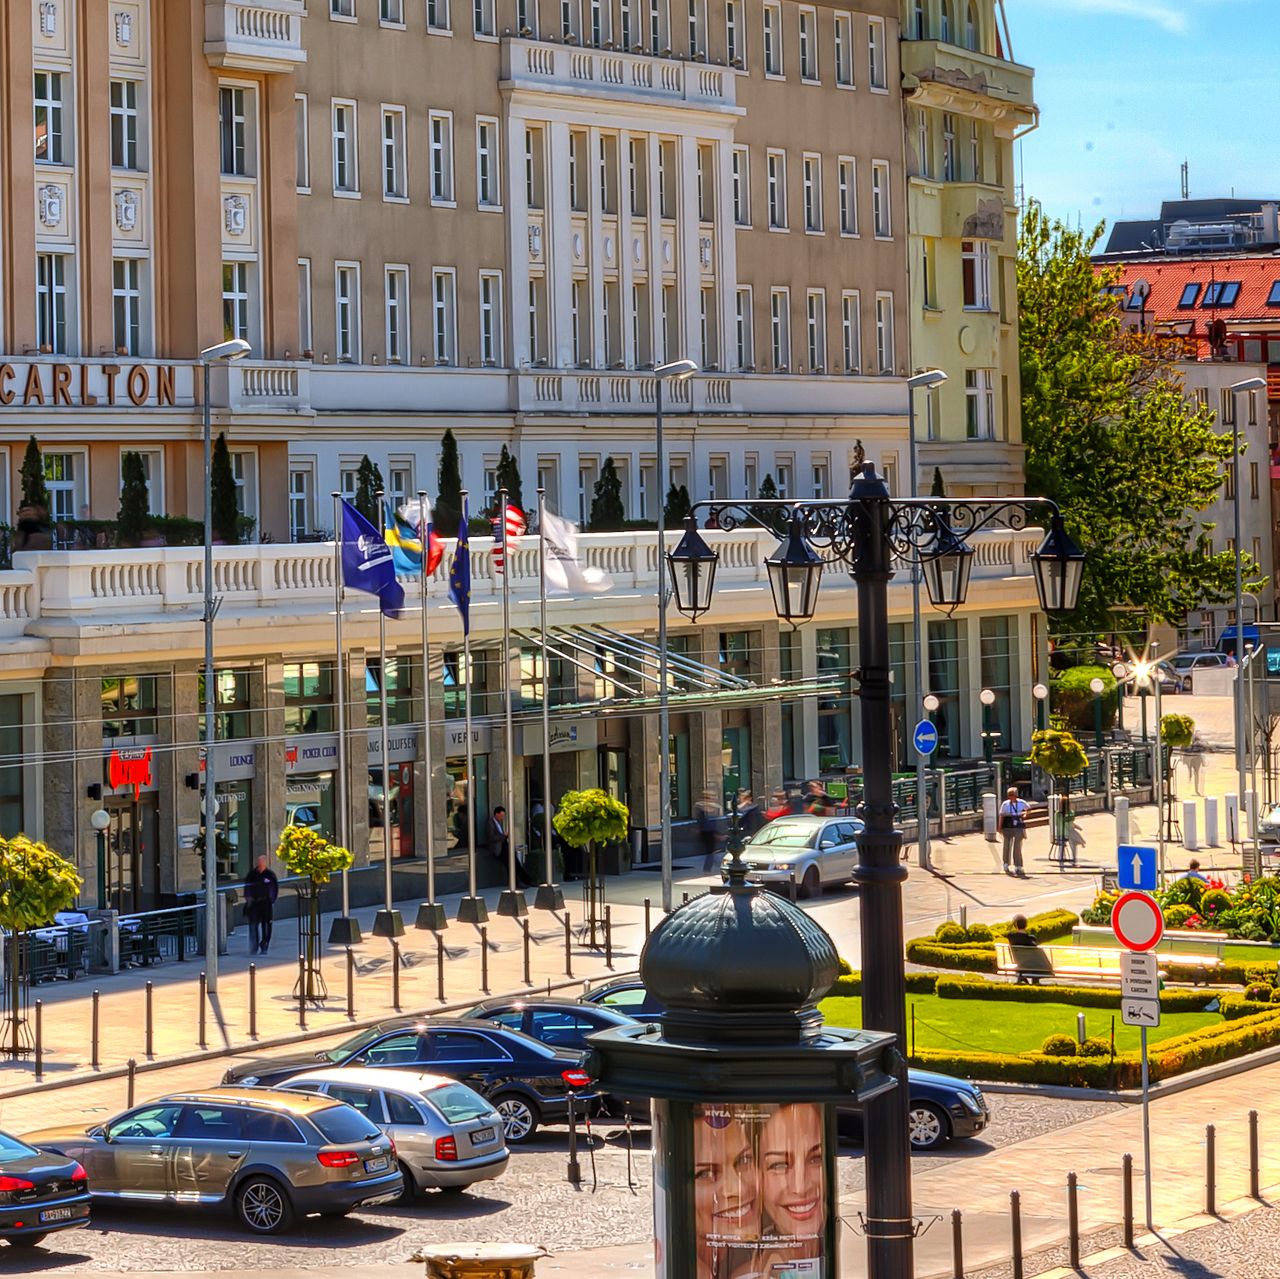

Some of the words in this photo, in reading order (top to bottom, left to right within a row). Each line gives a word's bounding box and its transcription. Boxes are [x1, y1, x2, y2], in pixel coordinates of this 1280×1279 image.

[388, 737, 416, 751] OLUFSEN
[303, 747, 321, 759] POKER
[230, 754, 254, 767] LOUNGE
[705, 1110, 731, 1118] NIVEA
